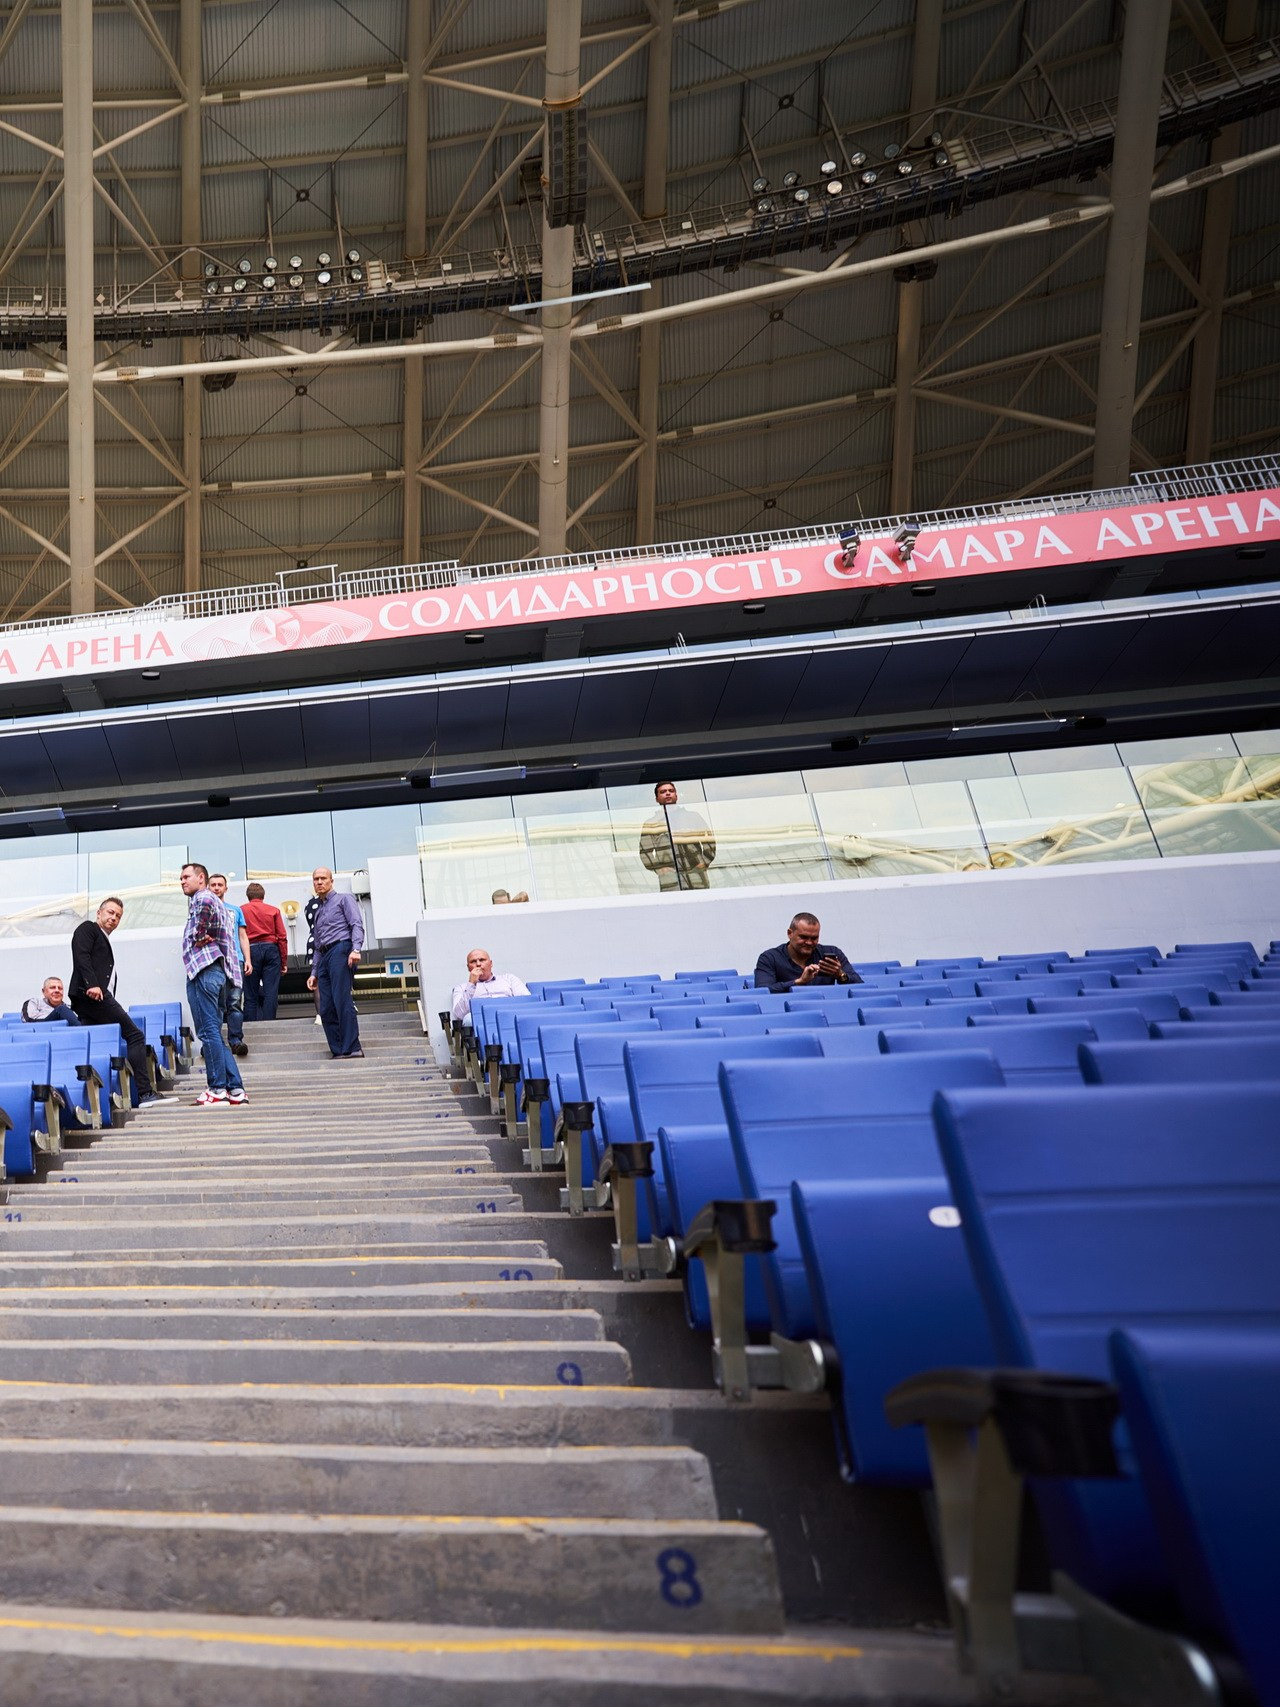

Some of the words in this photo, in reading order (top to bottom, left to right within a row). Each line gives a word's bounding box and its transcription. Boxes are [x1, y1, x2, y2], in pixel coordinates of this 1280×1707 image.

[378, 558, 802, 632] СОЛИДАРНОСТЬ
[823, 525, 1074, 579] САМАРА
[1096, 497, 1280, 551] АРЕНА
[35, 630, 175, 672] АРЕНА
[556, 1362, 583, 1386] 9
[656, 1547, 703, 1609] 8
